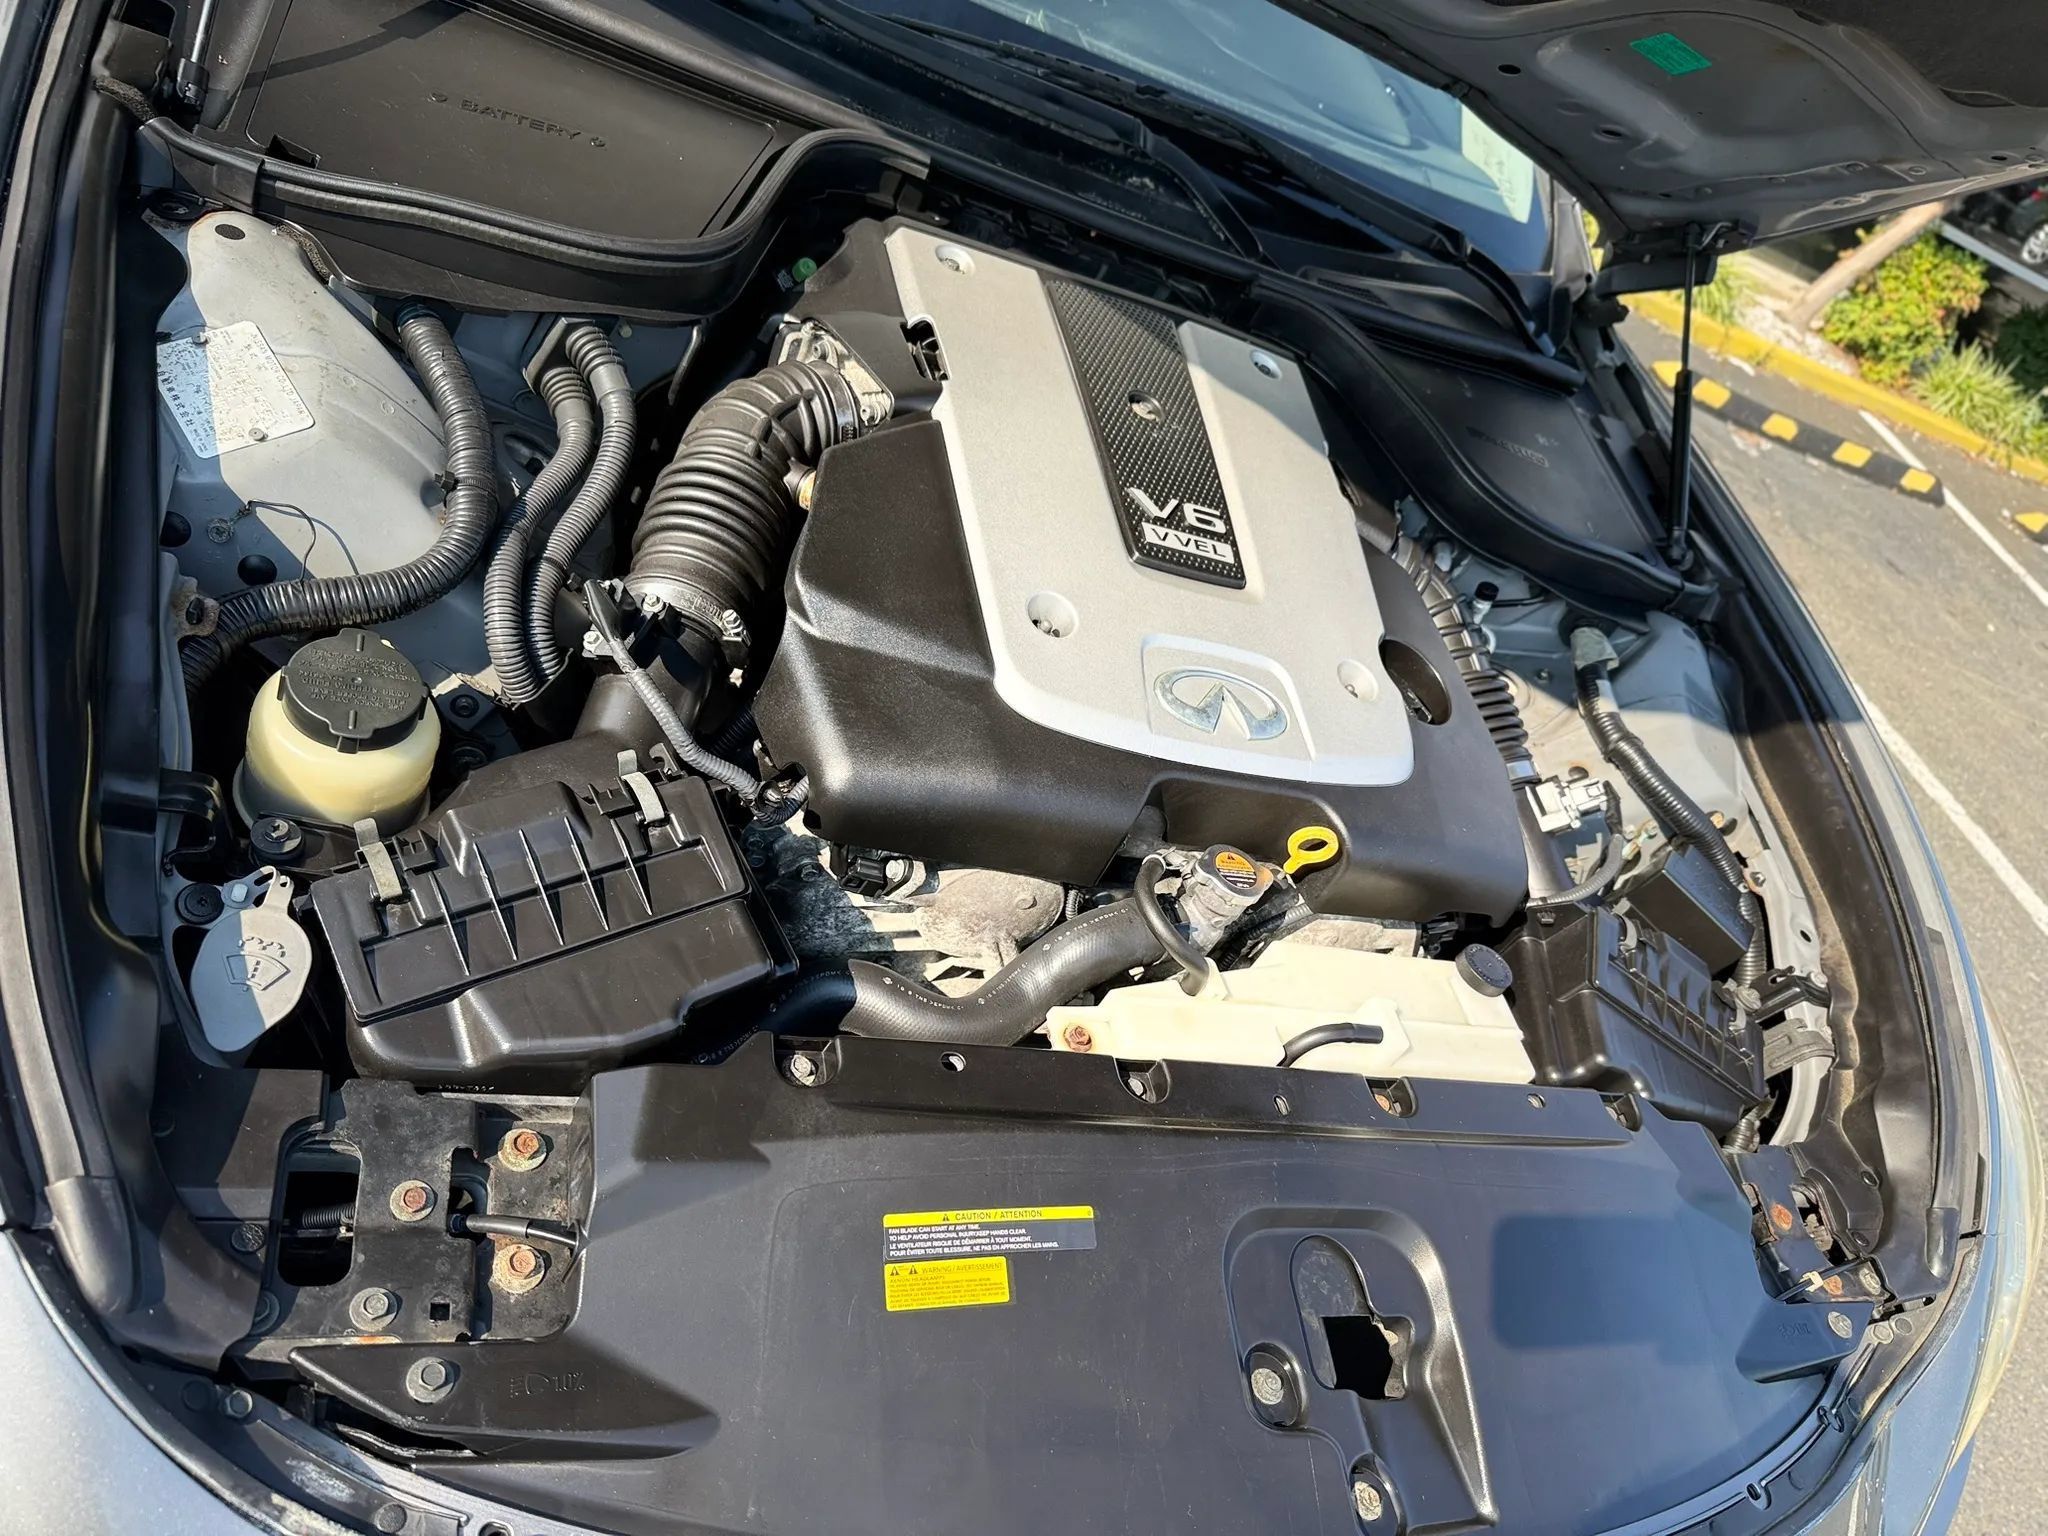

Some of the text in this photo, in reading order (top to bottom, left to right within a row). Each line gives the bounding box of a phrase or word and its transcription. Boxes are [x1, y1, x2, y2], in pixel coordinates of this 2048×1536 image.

[460, 99, 581, 140] BATTERY
[1125, 486, 1227, 534] V6
[1150, 527, 1227, 558] VVEL
[955, 1212, 991, 1221] CAUTION
[1000, 1210, 1042, 1219] ATTENTION
[897, 1241, 932, 1249] VENTILATEUR
[1000, 1242, 1032, 1250] APPROCHER
[921, 1266, 953, 1274] WARNING
[956, 1262, 1003, 1272] AVERTISSEMENT
